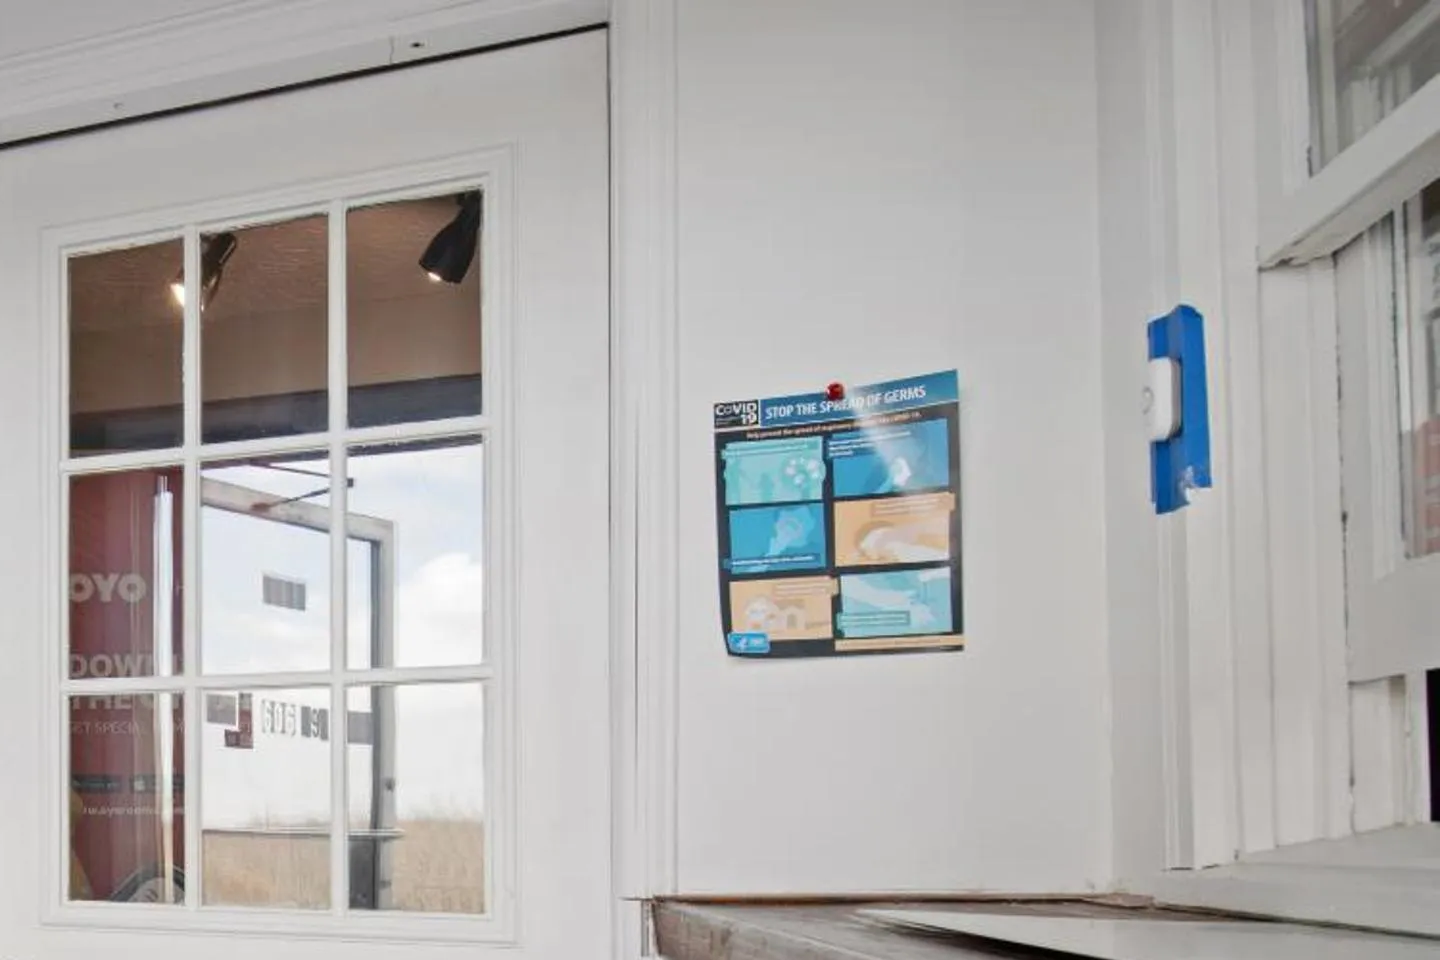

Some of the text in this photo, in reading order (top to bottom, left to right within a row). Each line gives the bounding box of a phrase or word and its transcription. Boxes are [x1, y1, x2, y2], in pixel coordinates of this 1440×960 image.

[765, 405, 794, 420] STOP
[796, 401, 817, 416] THE
[883, 385, 927, 404] GERMS
